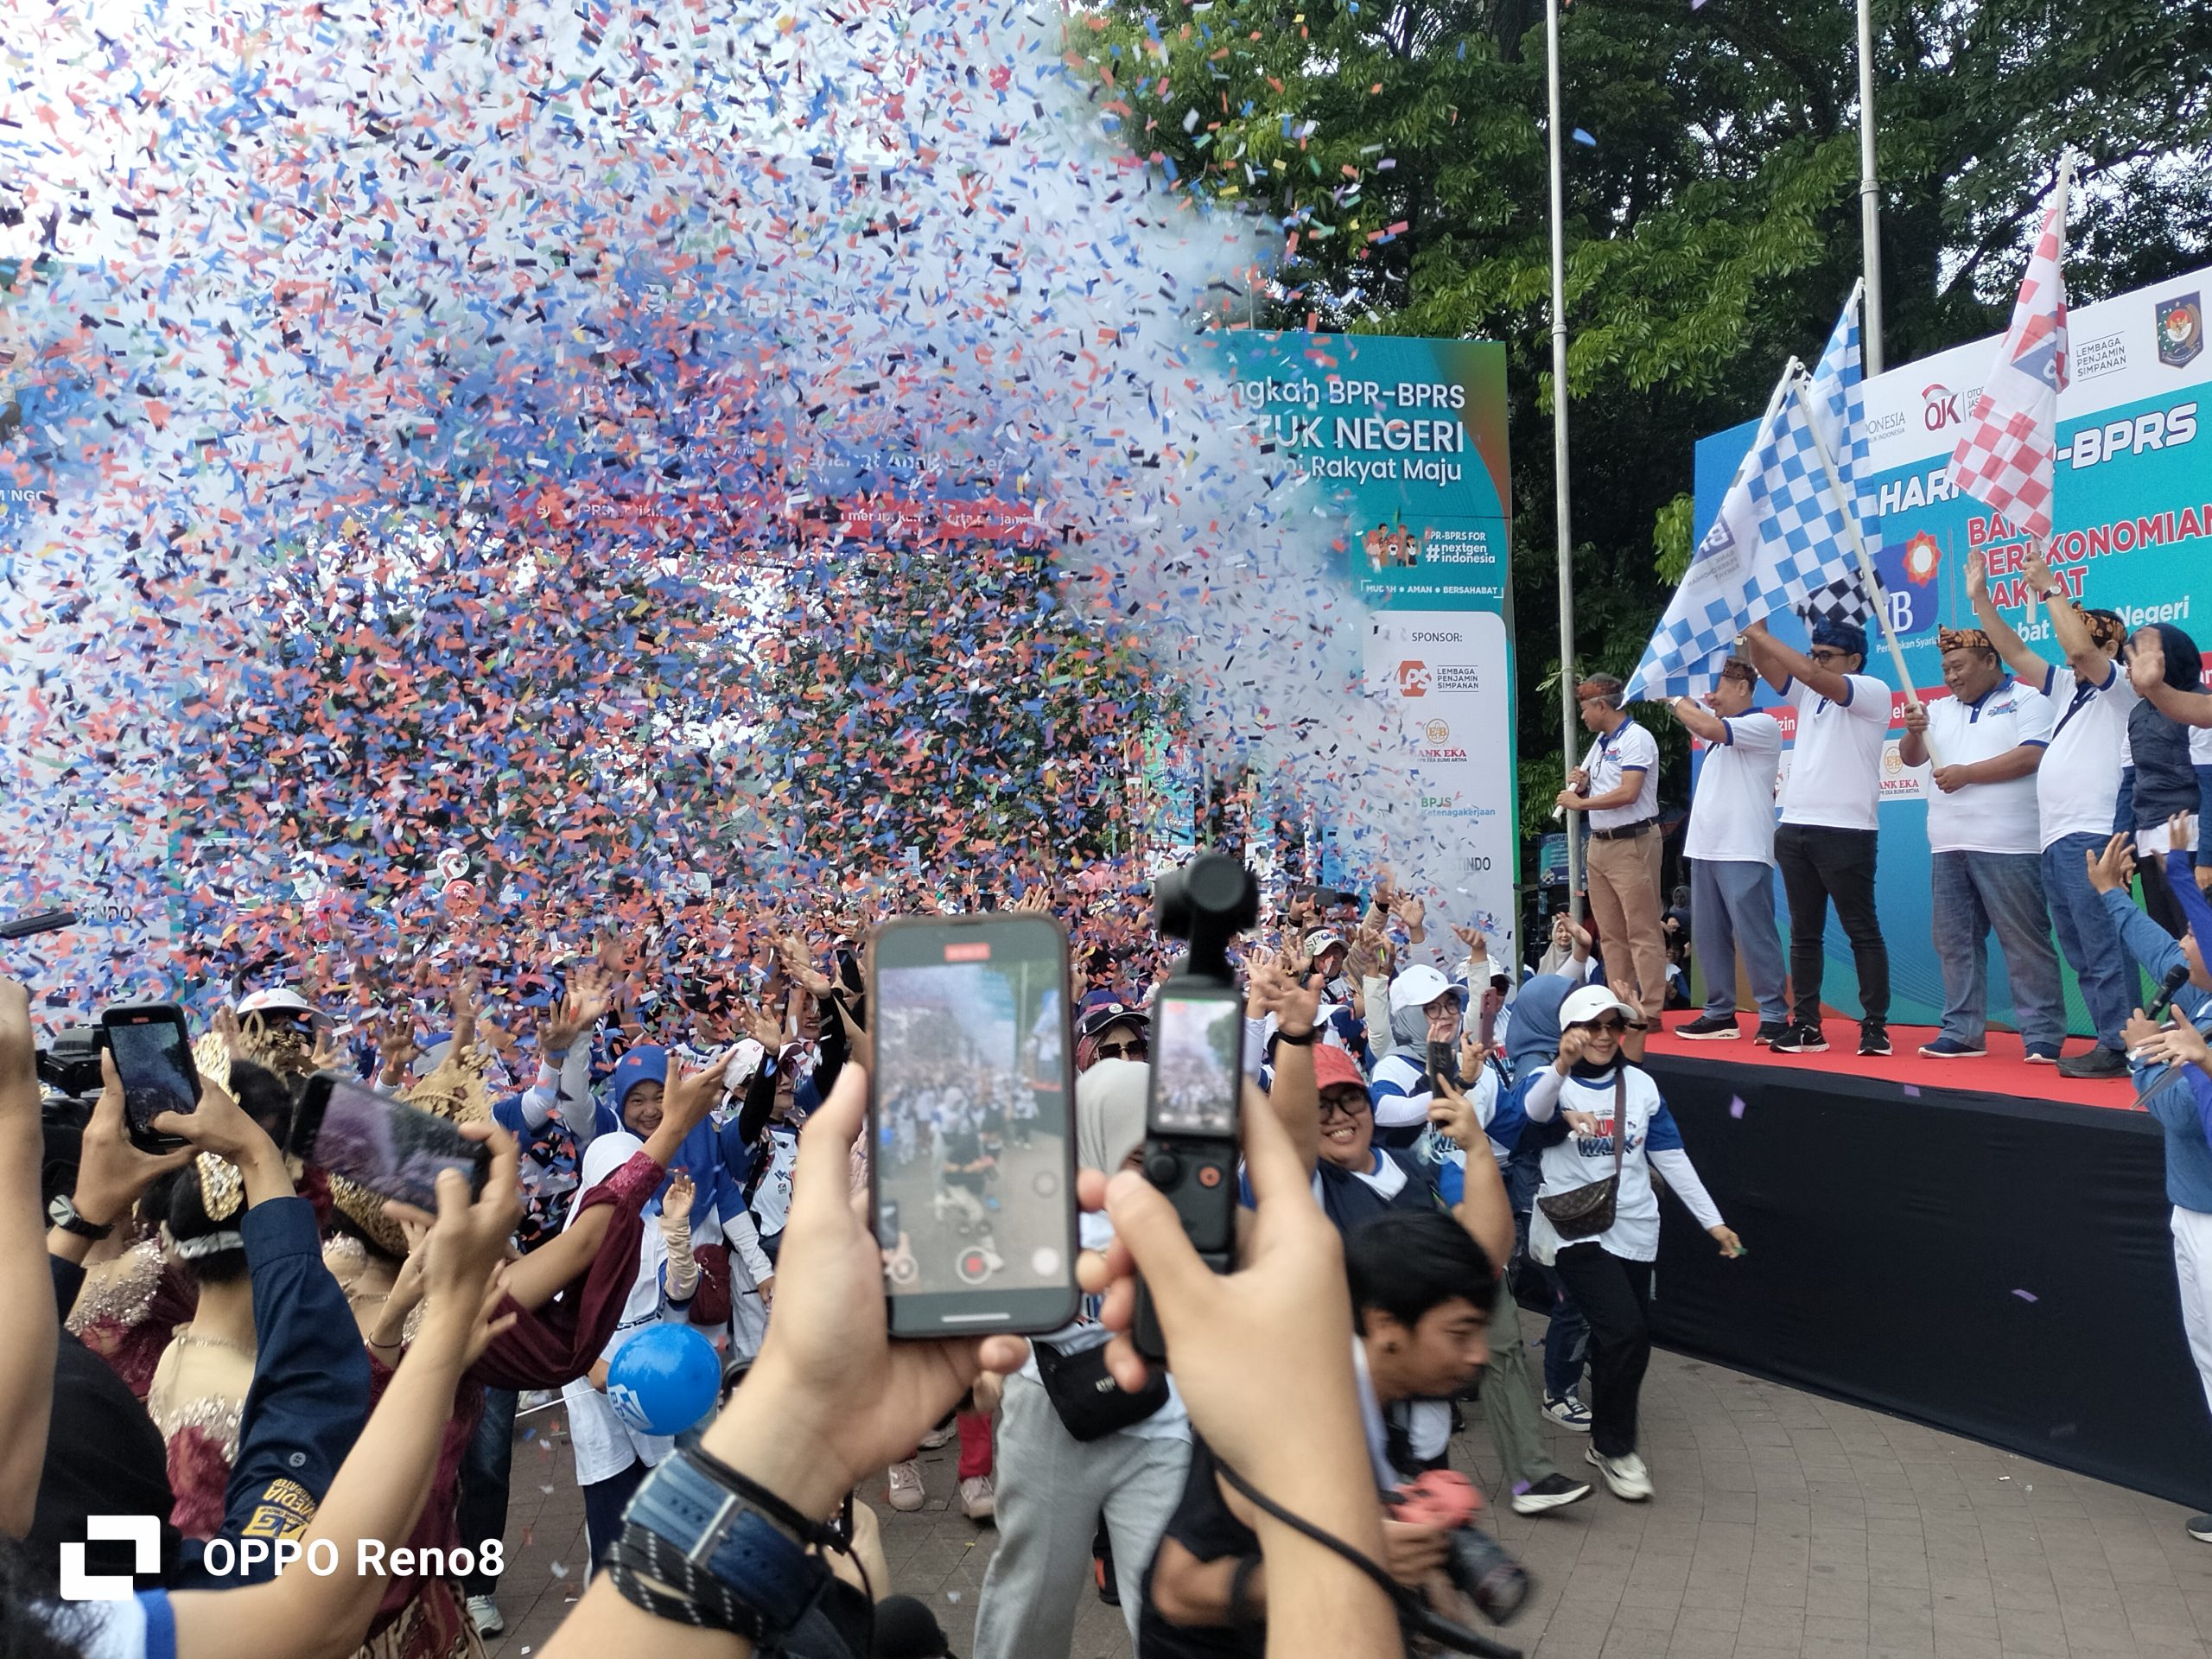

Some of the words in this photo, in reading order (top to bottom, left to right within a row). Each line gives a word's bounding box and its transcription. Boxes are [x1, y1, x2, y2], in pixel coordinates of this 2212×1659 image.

[2075, 338, 2121, 358] LEMBAGA
[2076, 346, 2126, 367] PENJAMIN
[2077, 356, 2127, 378] SIMPANAN
[1235, 376, 1319, 409] ngkah
[1328, 380, 1465, 409] BPR-BPRS
[1924, 393, 1961, 431] OJK
[1255, 415, 1325, 448] TUK
[1337, 417, 1464, 453] NEGERI
[2052, 401, 2199, 471] -BPRS
[1311, 455, 1397, 485] Rakyat
[1403, 458, 1462, 486] Maju
[1426, 531, 1467, 541] BPR-BPRS
[1468, 531, 1486, 541] FOR
[1967, 512, 2031, 548] BAN
[1441, 543, 1487, 556] nextgen
[1980, 503, 2212, 578] ERKONOMIA
[1441, 553, 1496, 563] indonesia
[1443, 586, 1498, 594] BERSAHABAT
[1971, 565, 2088, 616] AKAT
[1412, 632, 1463, 643] SPONSOR:
[1777, 716, 1796, 732] zin
[1899, 779, 1919, 788] EKA
[1421, 798, 1452, 808] BPJS
[1422, 808, 1496, 817] etenagakerjaan
